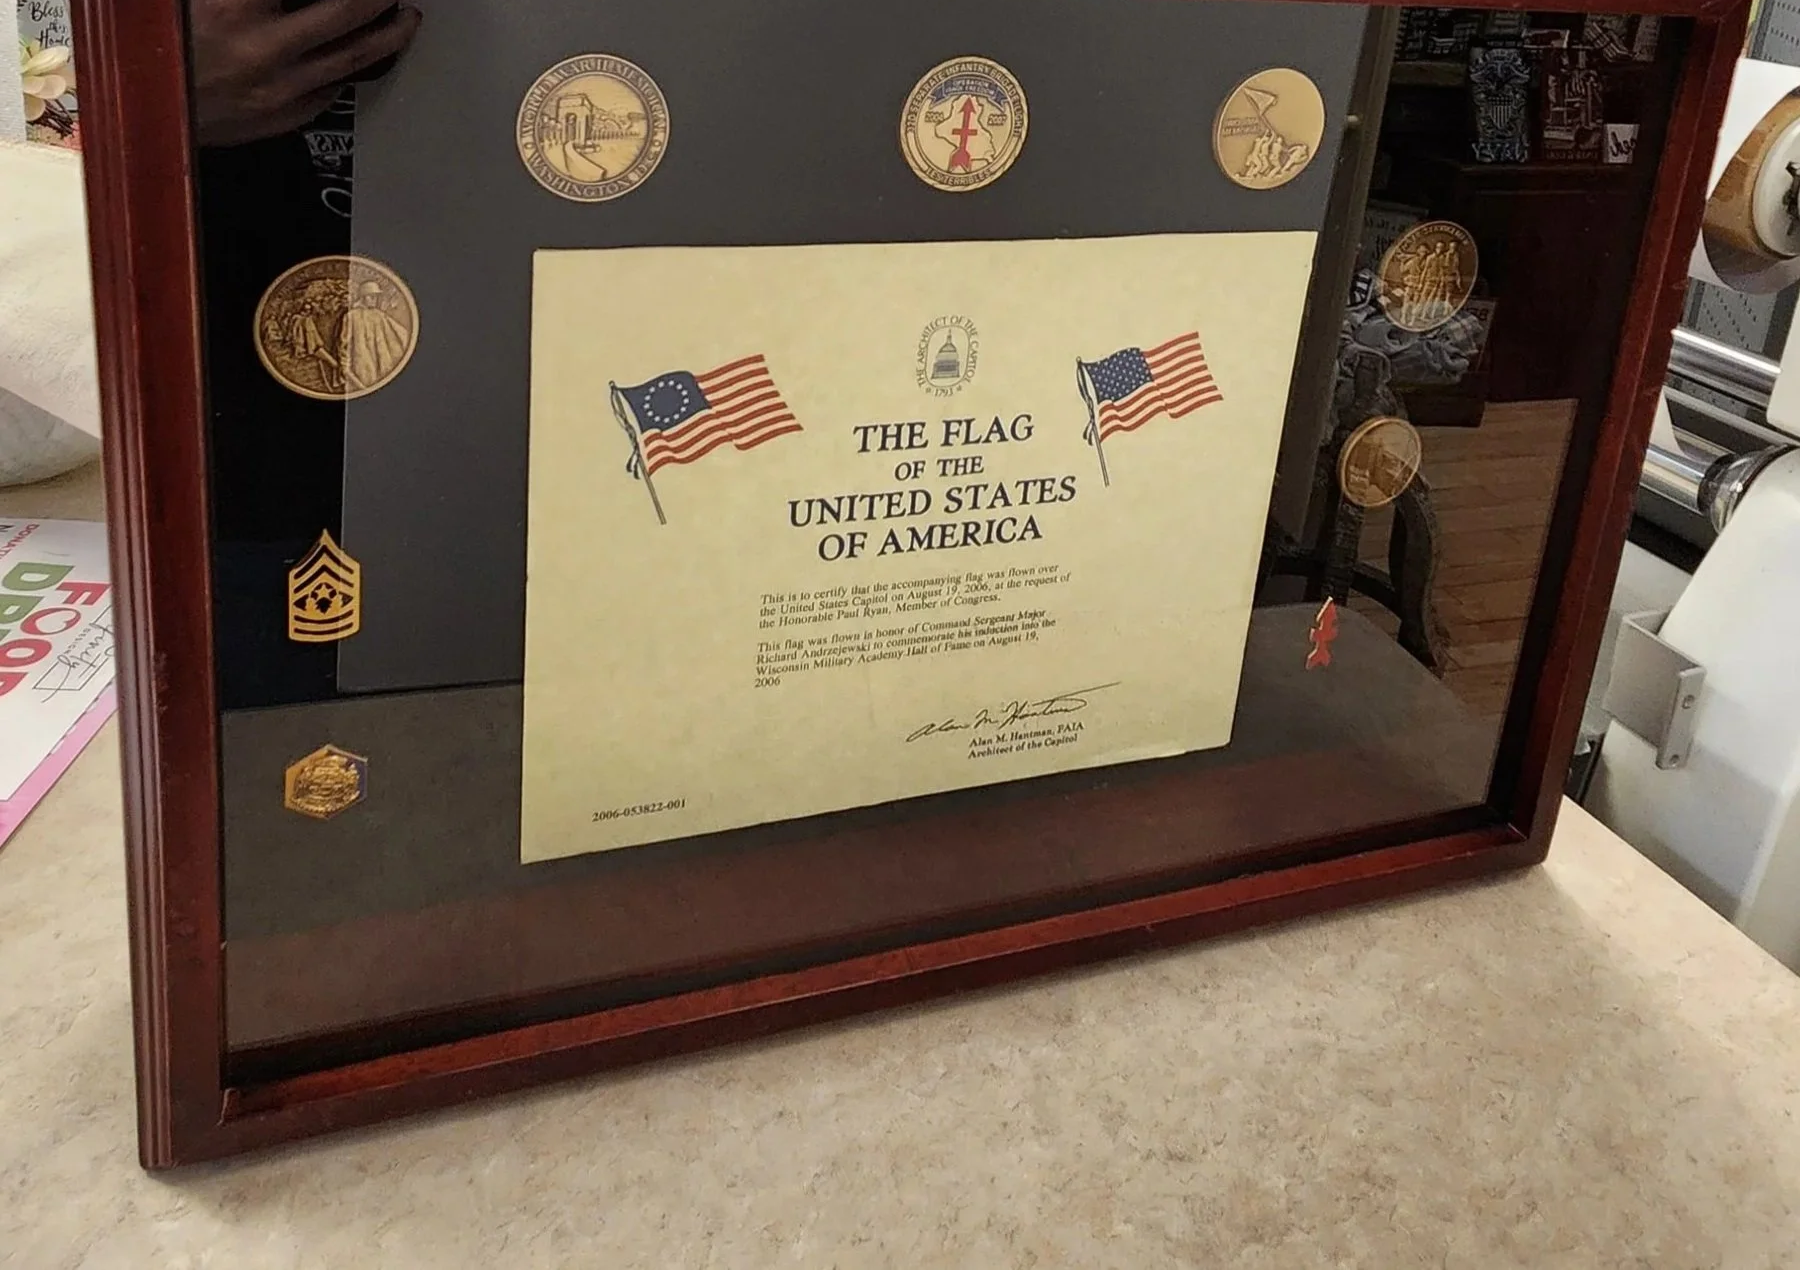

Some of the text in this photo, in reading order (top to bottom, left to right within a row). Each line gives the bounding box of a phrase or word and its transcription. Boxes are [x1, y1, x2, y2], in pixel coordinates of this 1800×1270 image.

[29, 0, 63, 22] Bless
[910, 72, 946, 115] SEPARATE
[945, 62, 990, 76] INFANTRY
[917, 316, 947, 364] ARCHITECT
[950, 315, 965, 325] OF
[853, 414, 1034, 453] THE FLAG
[894, 455, 985, 481] OF THE
[788, 475, 1076, 527] UNITED STATES
[0, 524, 40, 559] DONAT
[818, 514, 1043, 561] OF AMERICA
[760, 564, 1059, 605] This is to certify that the accompanying flag was flown over
[760, 606, 776, 617] the
[780, 602, 815, 615] United
[818, 599, 849, 611] States
[851, 593, 888, 609] Capitol
[891, 593, 904, 602] on
[907, 589, 942, 602] August
[964, 583, 992, 594] 2006,
[994, 581, 1005, 590] at
[1007, 578, 1022, 588] the
[1024, 575, 1058, 588] request
[1060, 571, 1072, 582] of
[757, 609, 1046, 653] This flag was flown in honor of Command Sergeant Major
[759, 593, 1001, 629] the Honorable Paul Ryan, Member of Congress.
[756, 617, 1056, 665] Richard Andrzejewski to commemorate his induction into the
[756, 660, 810, 676] Wisconsin
[813, 655, 854, 670] Military
[857, 649, 904, 664] Academy
[905, 643, 928, 657] Hall
[930, 642, 942, 653] of
[944, 640, 971, 652] Fame
[973, 639, 986, 648] on
[988, 634, 1022, 646] August
[754, 676, 781, 688] 2006
[968, 734, 1078, 759] Architect of the Capitol
[969, 721, 1084, 748] Alan M. Hantman, FAIA
[591, 798, 686, 822] 2006-053822-001
